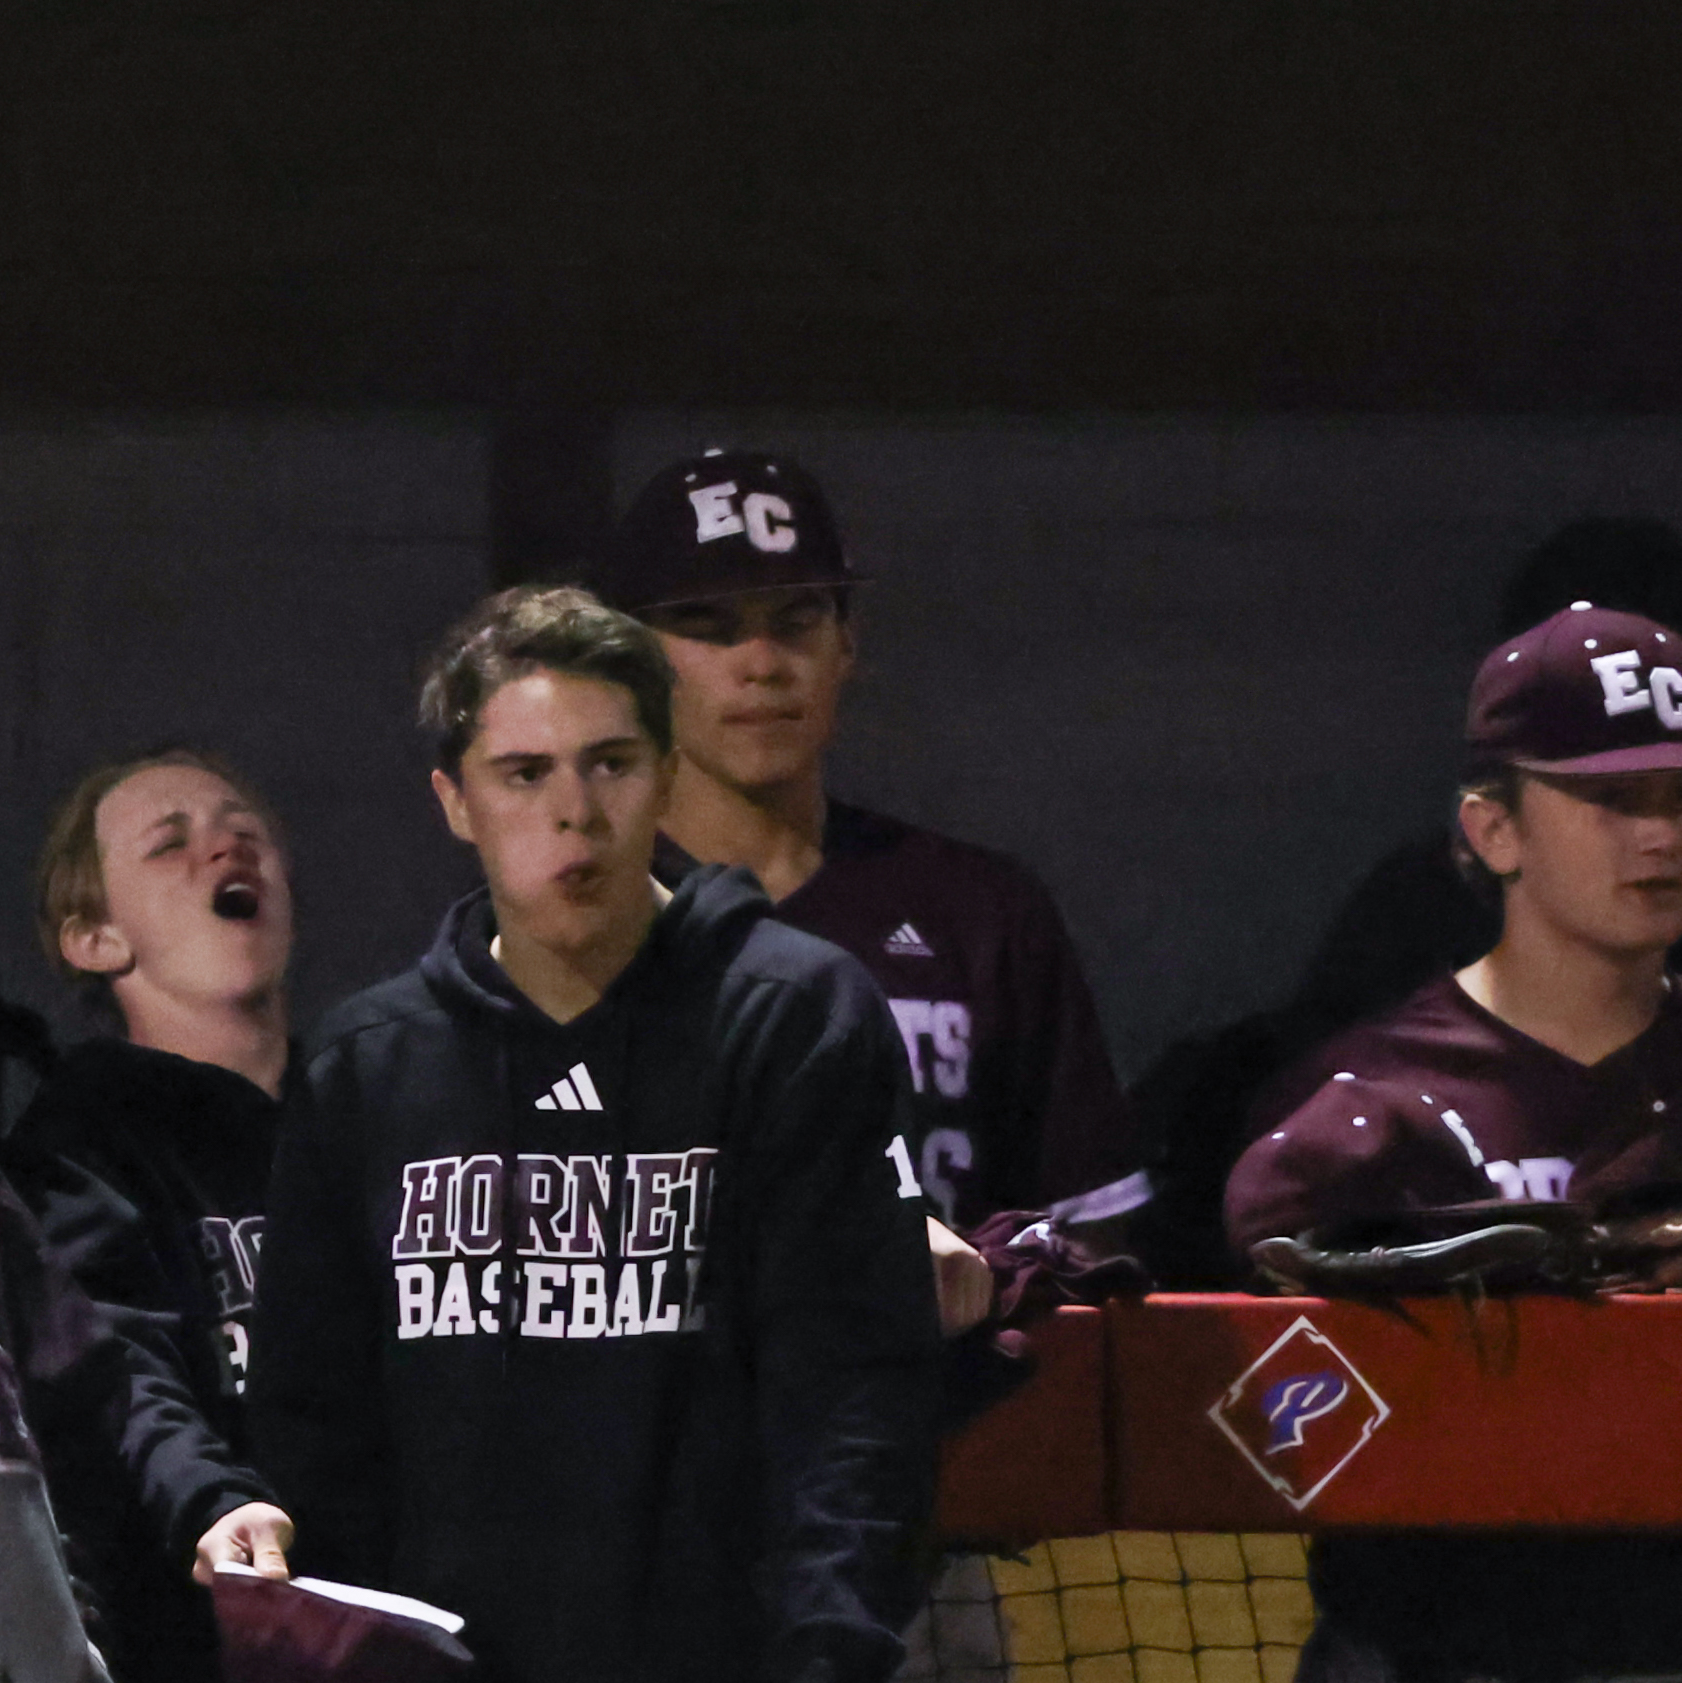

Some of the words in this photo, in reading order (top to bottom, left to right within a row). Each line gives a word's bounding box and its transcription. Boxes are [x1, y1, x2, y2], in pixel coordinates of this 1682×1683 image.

[689, 481, 797, 552] EC
[1590, 650, 1682, 731] EC
[392, 1148, 719, 1260] HORNET
[394, 1259, 706, 1340] BASEBALL
